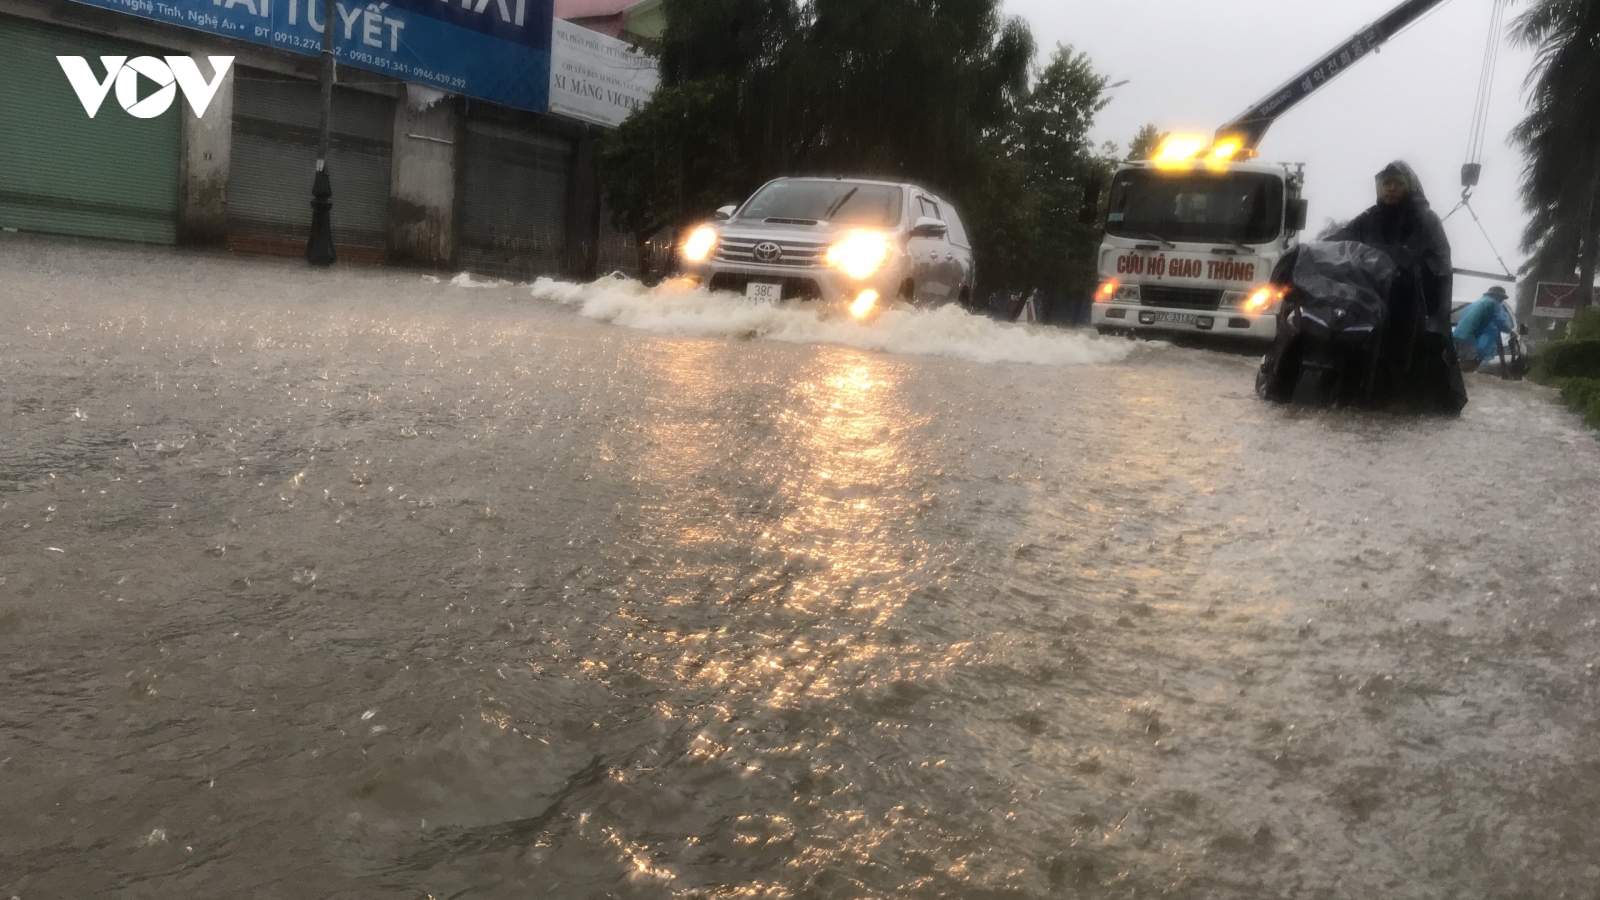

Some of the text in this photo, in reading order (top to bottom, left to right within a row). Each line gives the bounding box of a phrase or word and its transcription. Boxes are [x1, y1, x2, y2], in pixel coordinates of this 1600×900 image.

[188, 10, 218, 29] Nghệ
[222, 18, 236, 30] An
[254, 26, 270, 38] ĐT
[554, 74, 566, 90] XI
[570, 78, 603, 101] MĂNG
[1117, 250, 1255, 281] CỨU HỘ GIAO THÔNG
[754, 284, 773, 296] 38C
